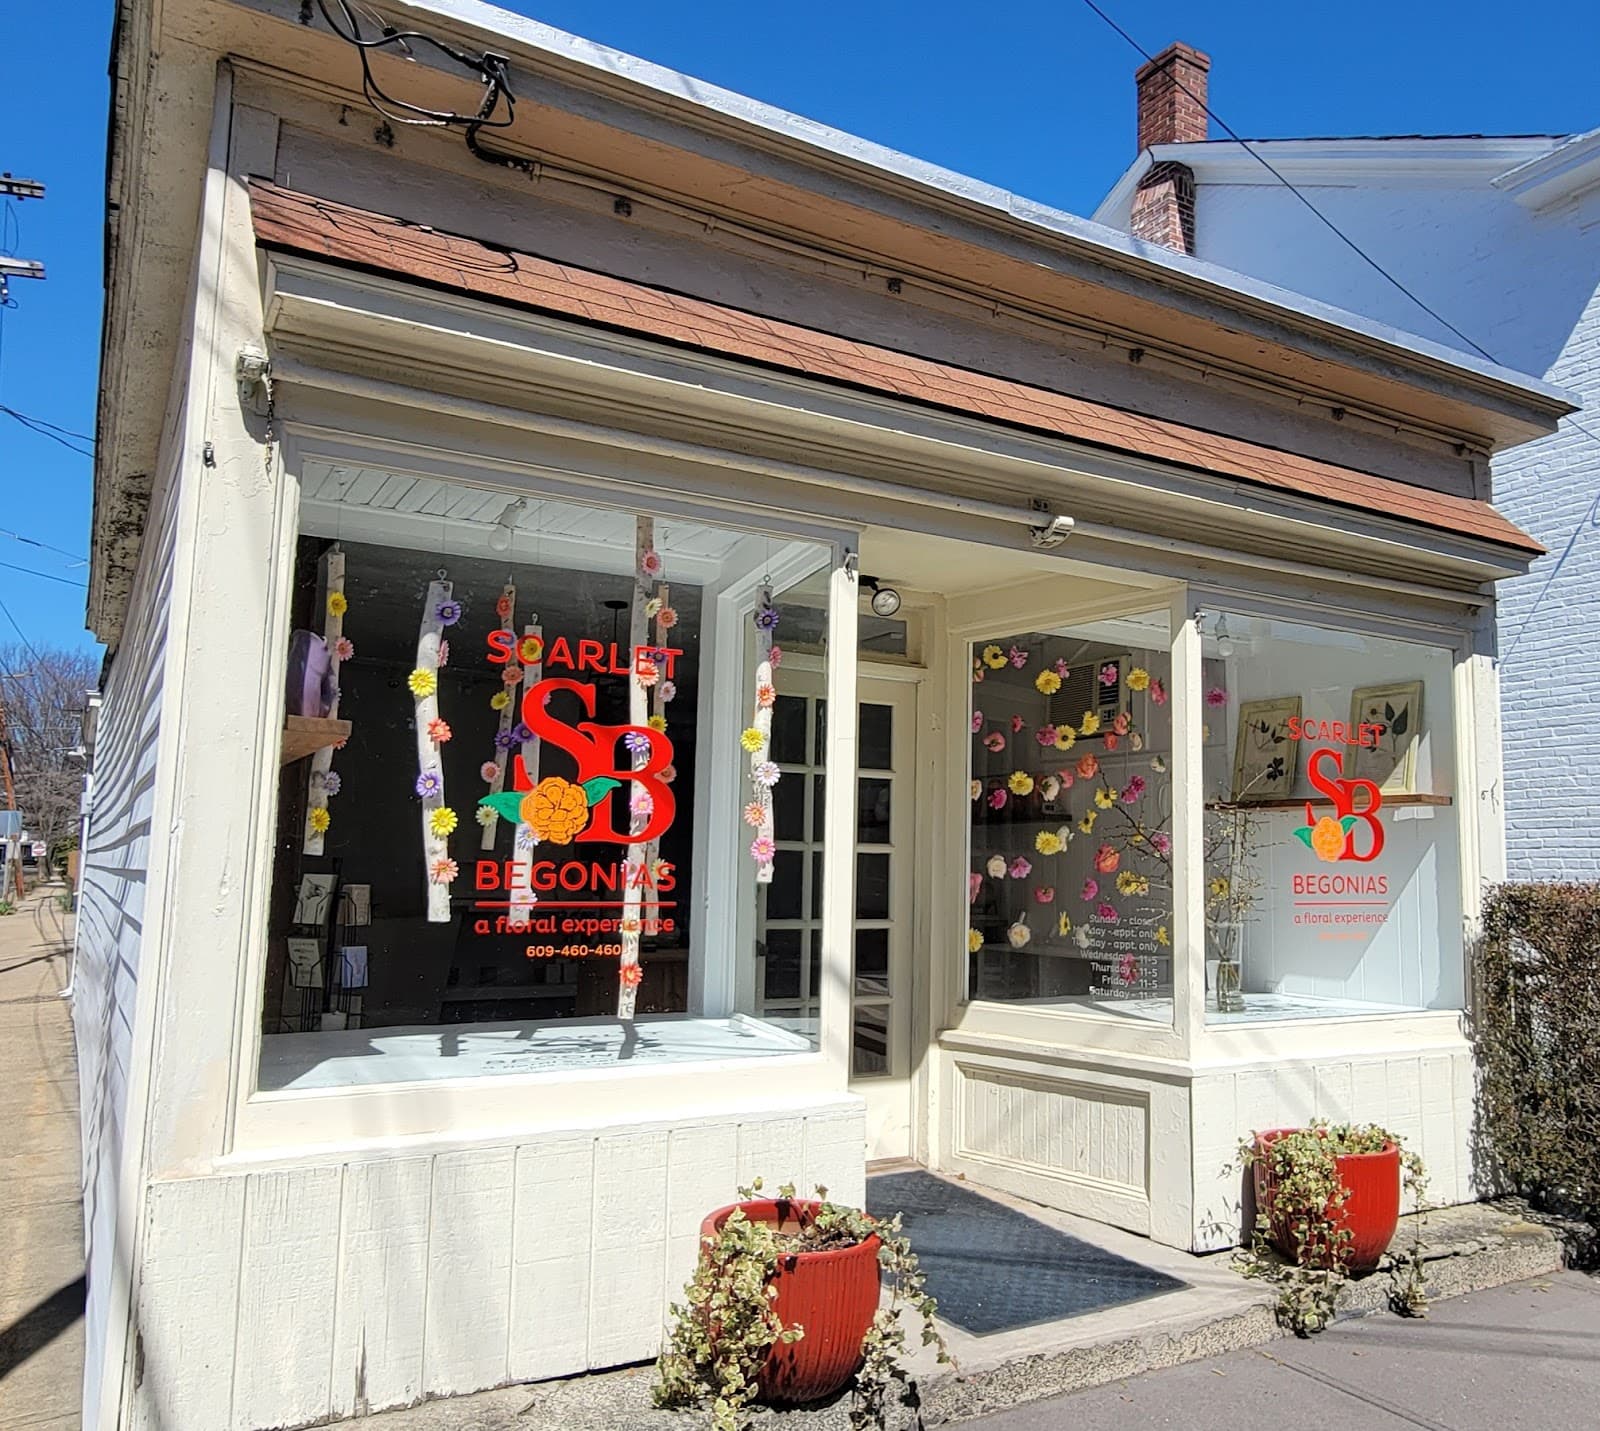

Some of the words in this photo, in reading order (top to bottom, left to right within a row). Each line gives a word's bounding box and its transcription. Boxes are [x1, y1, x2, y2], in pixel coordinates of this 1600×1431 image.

[487, 630, 684, 679] SCARLET
[1288, 716, 1384, 747] SCARLET
[476, 860, 676, 892] BEGONIAS
[1292, 874, 1388, 895] BEGONIAS
[474, 919, 491, 934] a
[496, 915, 557, 934] floral
[1089, 913, 1121, 926] Sunday
[1294, 914, 1301, 924] a
[1303, 911, 1332, 924] floral
[1334, 911, 1388, 925] experience
[1138, 928, 1158, 941] only
[526, 944, 629, 957] 609-460-460
[1072, 936, 1106, 949] Tuday
[1138, 941, 1158, 953] only
[1080, 949, 1129, 963] Wednesday
[1139, 955, 1158, 965] 11-5
[1090, 962, 1131, 976] Thursday
[1139, 966, 1158, 978] 11-5
[1101, 975, 1130, 988] Friday
[1139, 979, 1158, 989] 11-5
[1088, 985, 1130, 999] Saturday
